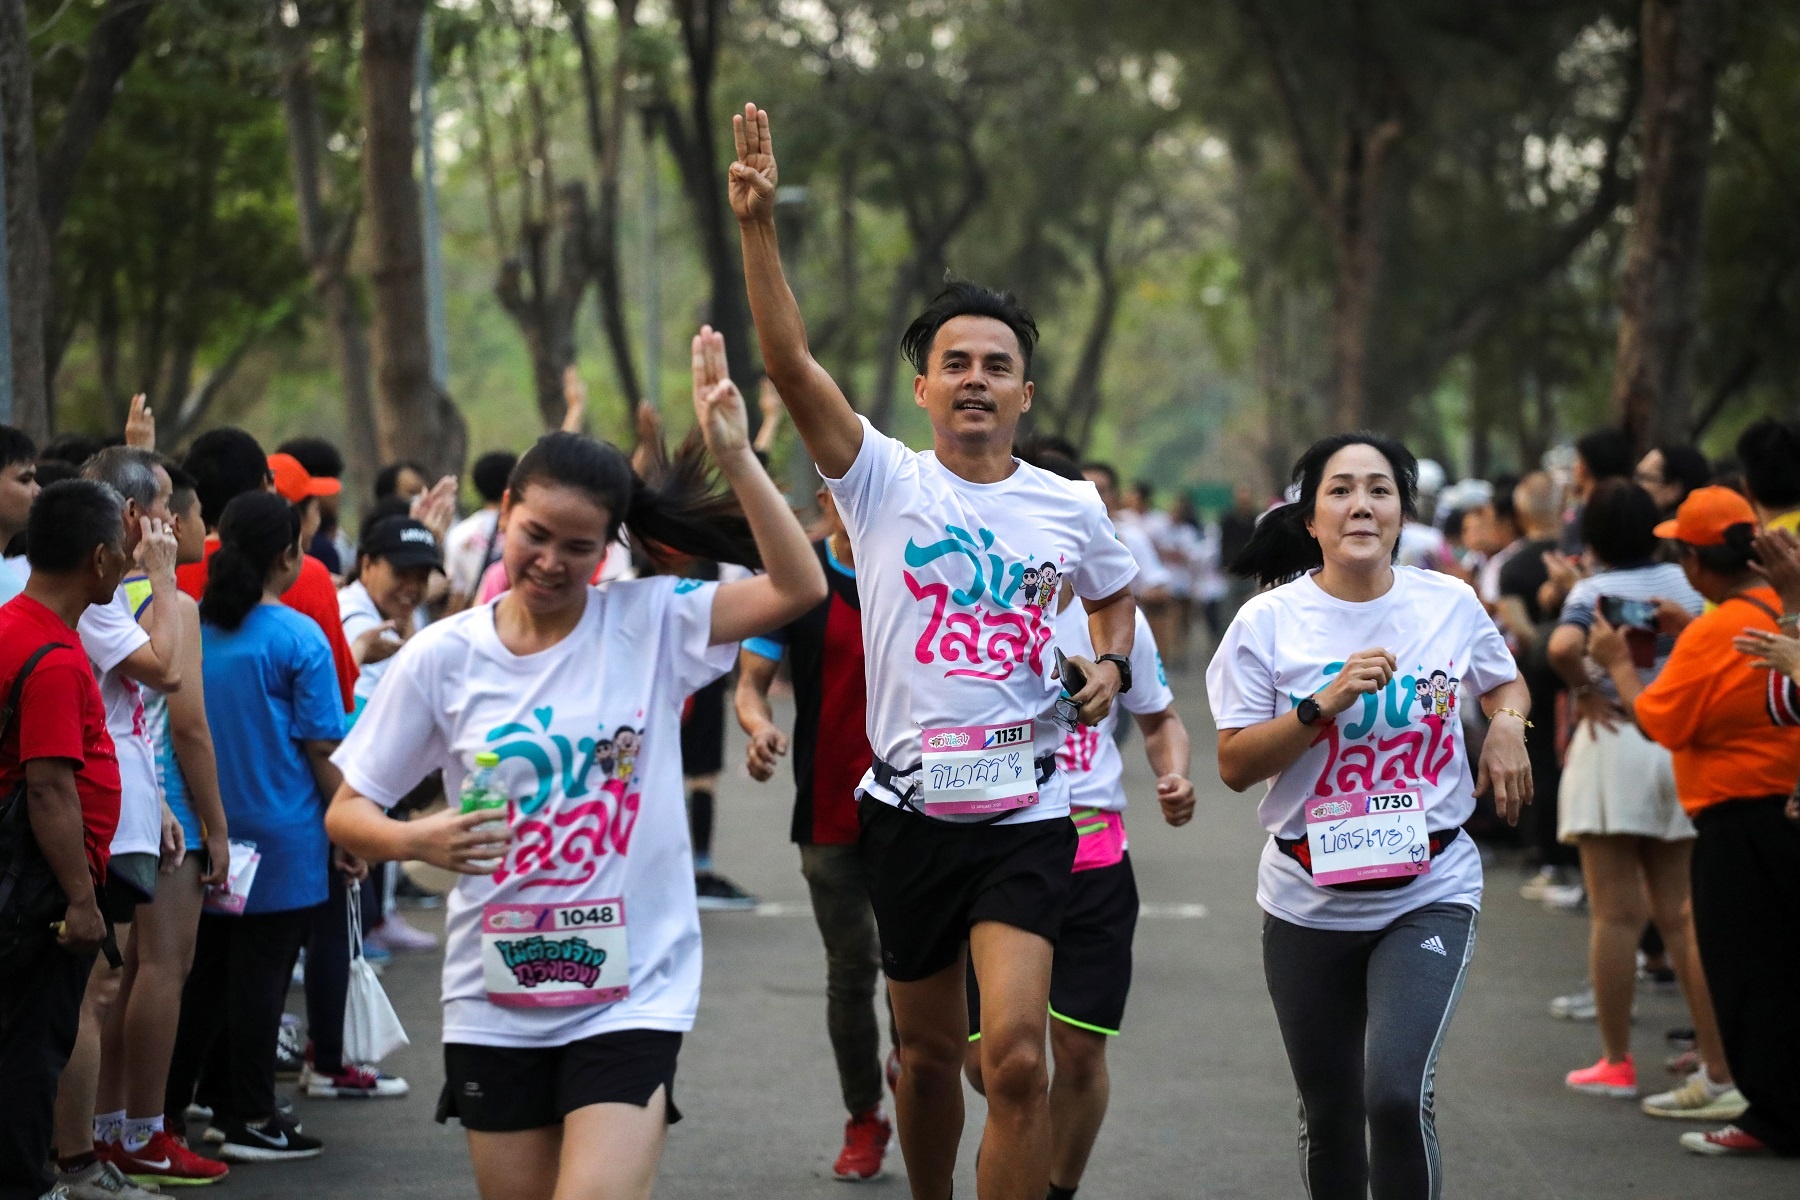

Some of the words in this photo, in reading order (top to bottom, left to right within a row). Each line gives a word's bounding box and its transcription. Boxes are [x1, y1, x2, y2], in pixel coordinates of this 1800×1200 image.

[904, 524, 1025, 609] วิ่ง
[995, 727, 1023, 744] 1131
[1372, 794, 1413, 811] 1730
[560, 906, 614, 926] 1048
[1420, 943, 1447, 957] adidas
